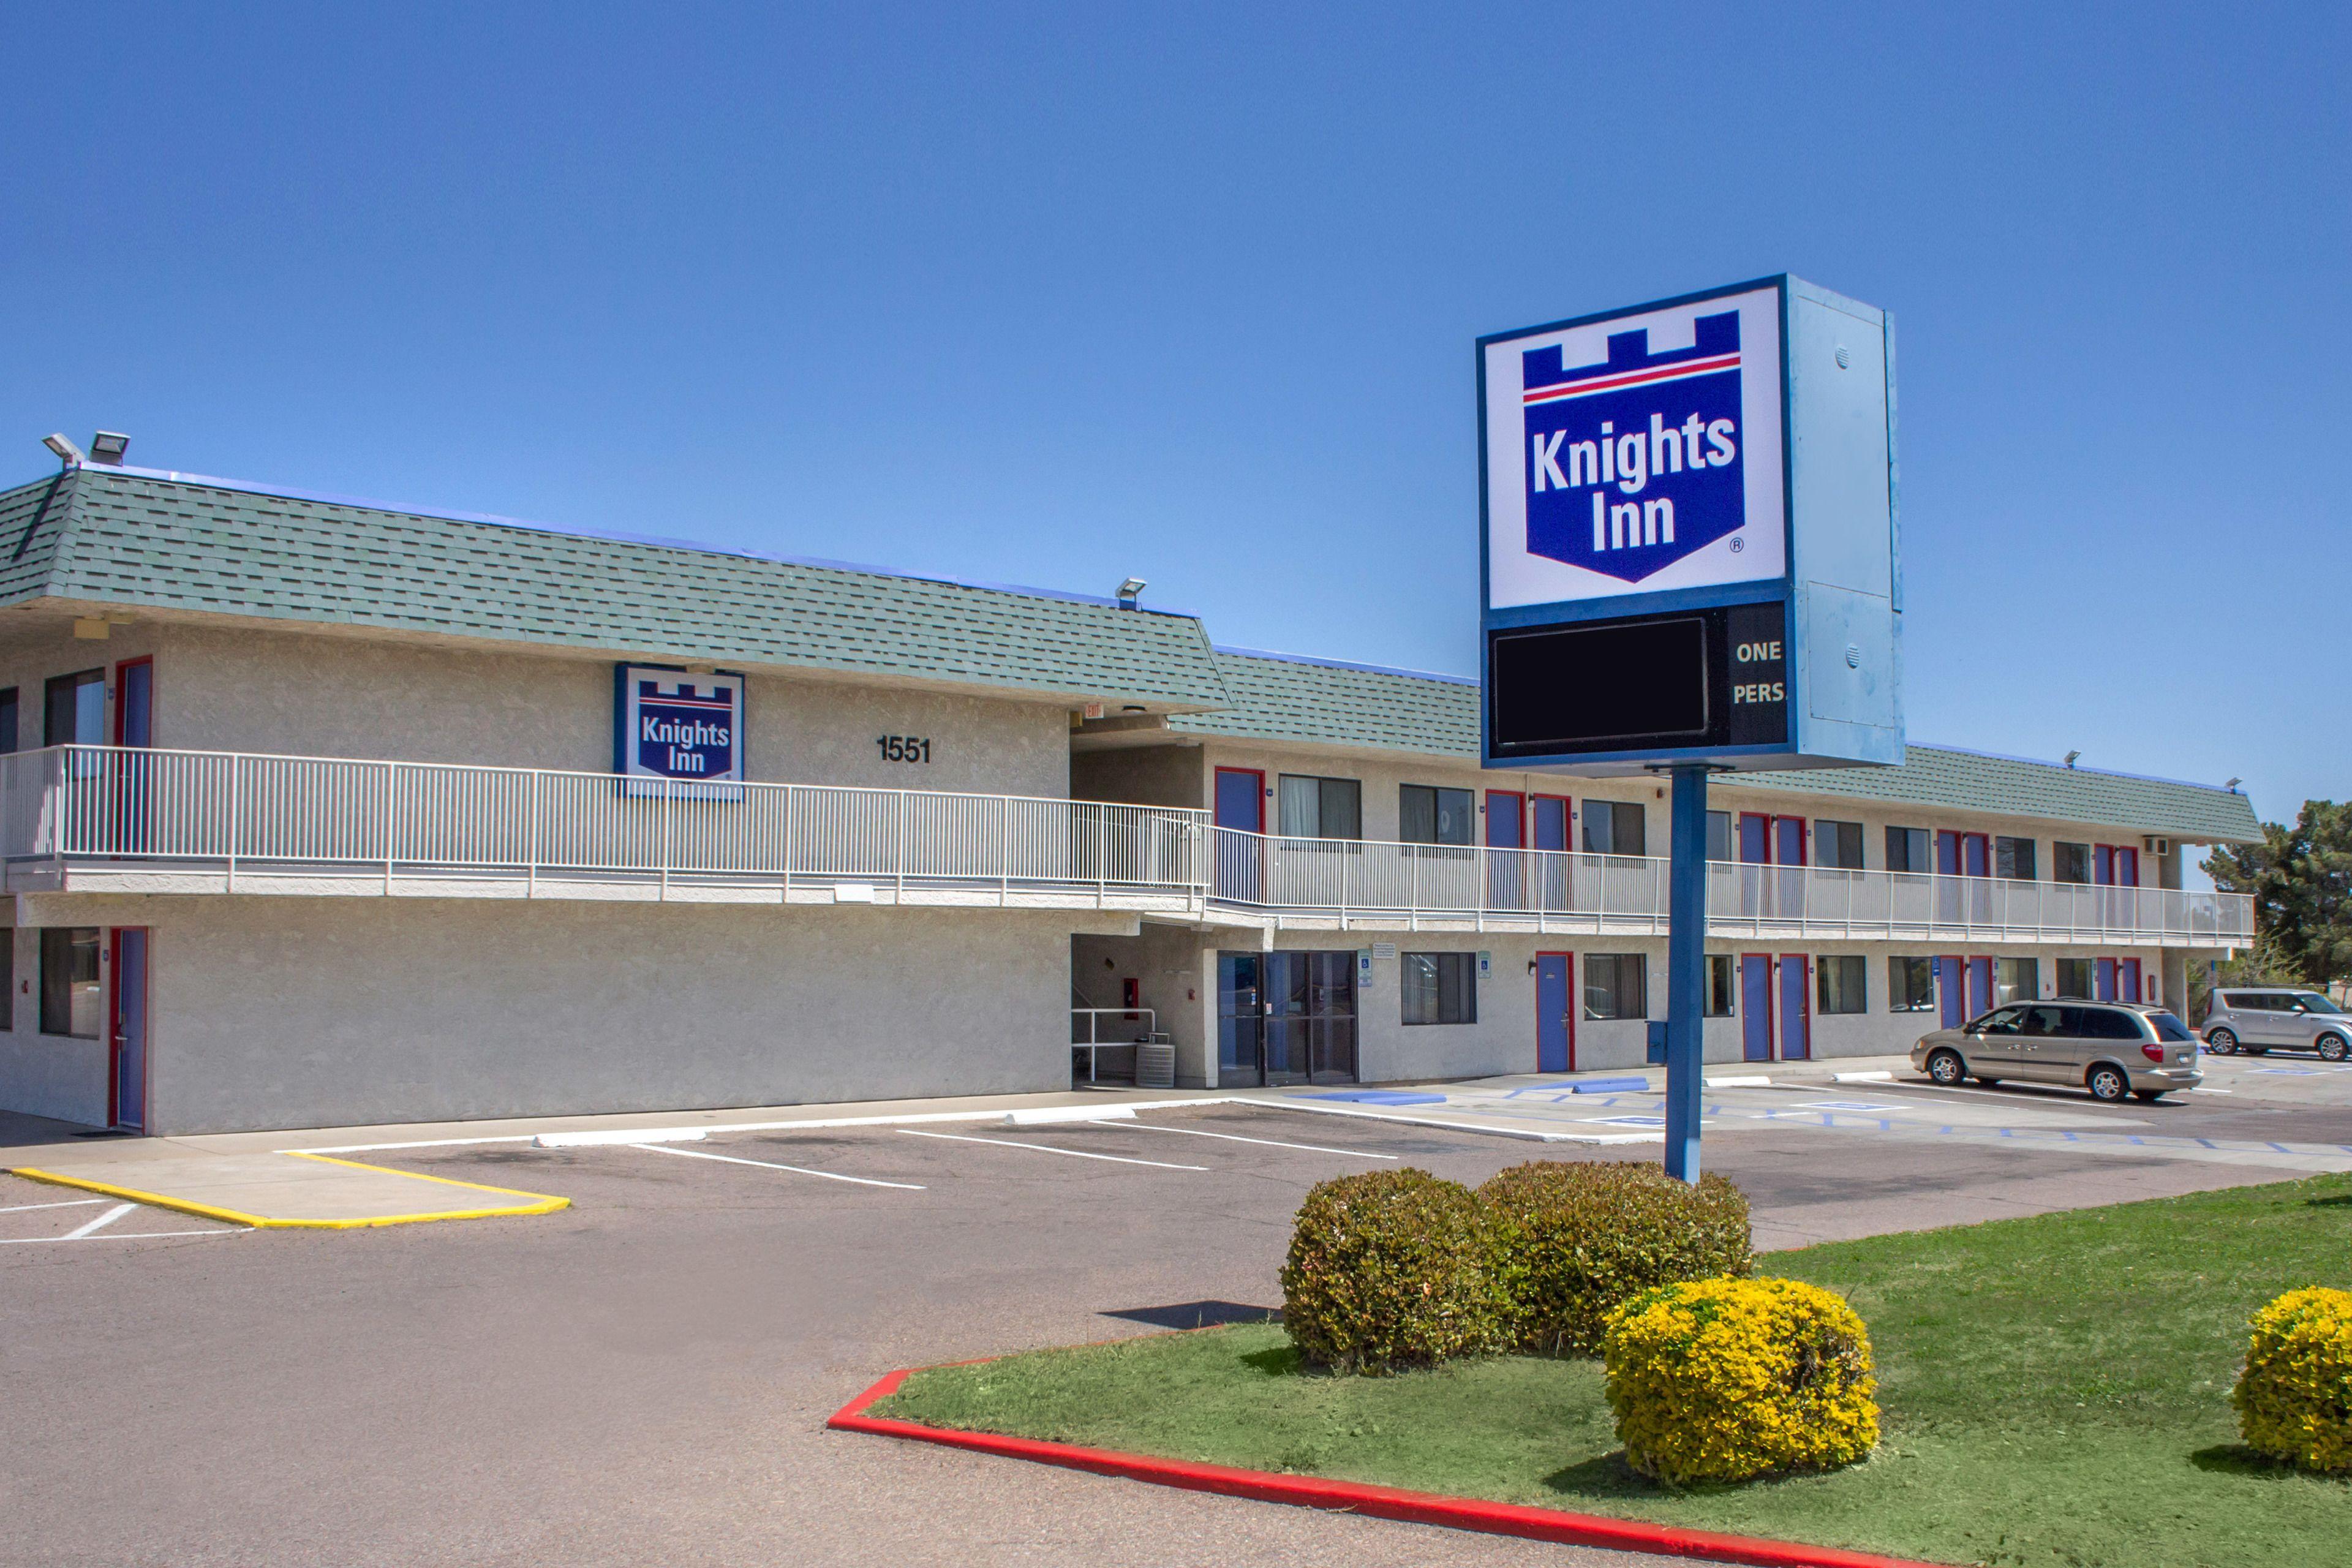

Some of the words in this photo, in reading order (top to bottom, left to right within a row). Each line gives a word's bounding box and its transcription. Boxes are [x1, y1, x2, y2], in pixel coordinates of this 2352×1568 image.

[1533, 412, 1736, 494] Knights
[1593, 491, 1675, 552] Inn
[1736, 641, 1782, 663] ONE
[643, 716, 729, 750] Knights
[876, 734, 930, 764] 1551
[668, 745, 704, 772] Inn
